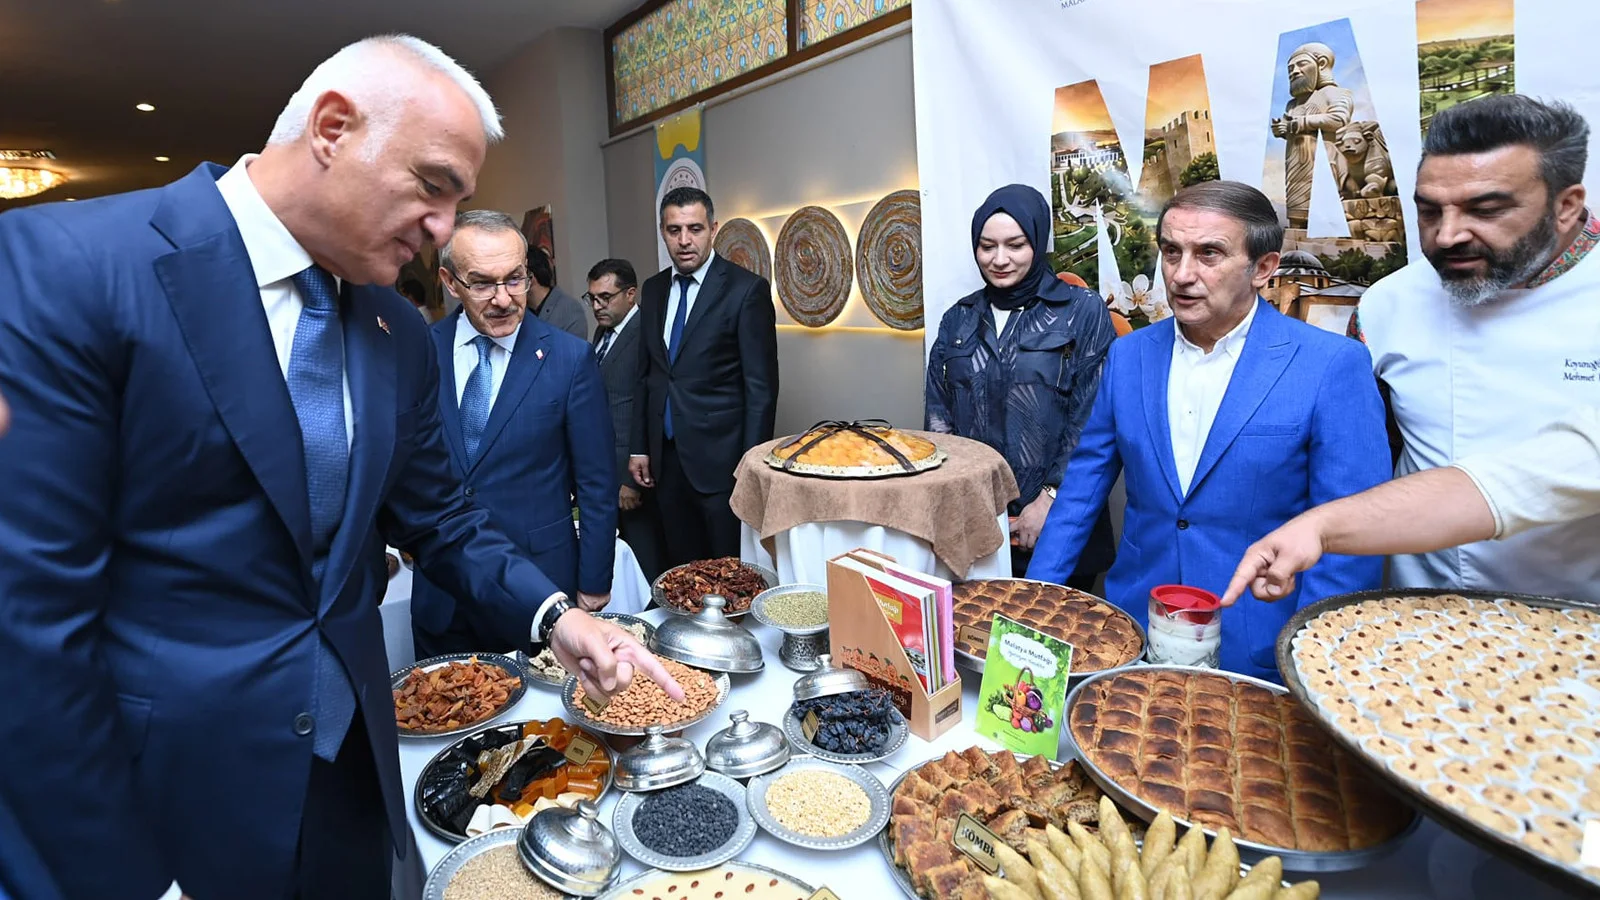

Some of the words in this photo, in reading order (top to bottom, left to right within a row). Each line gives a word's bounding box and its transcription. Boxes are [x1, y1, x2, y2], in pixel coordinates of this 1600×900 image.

[1563, 371, 1595, 382] Mehmet
[1004, 639, 1027, 653] Malatya
[1028, 649, 1053, 665] Mutfağı
